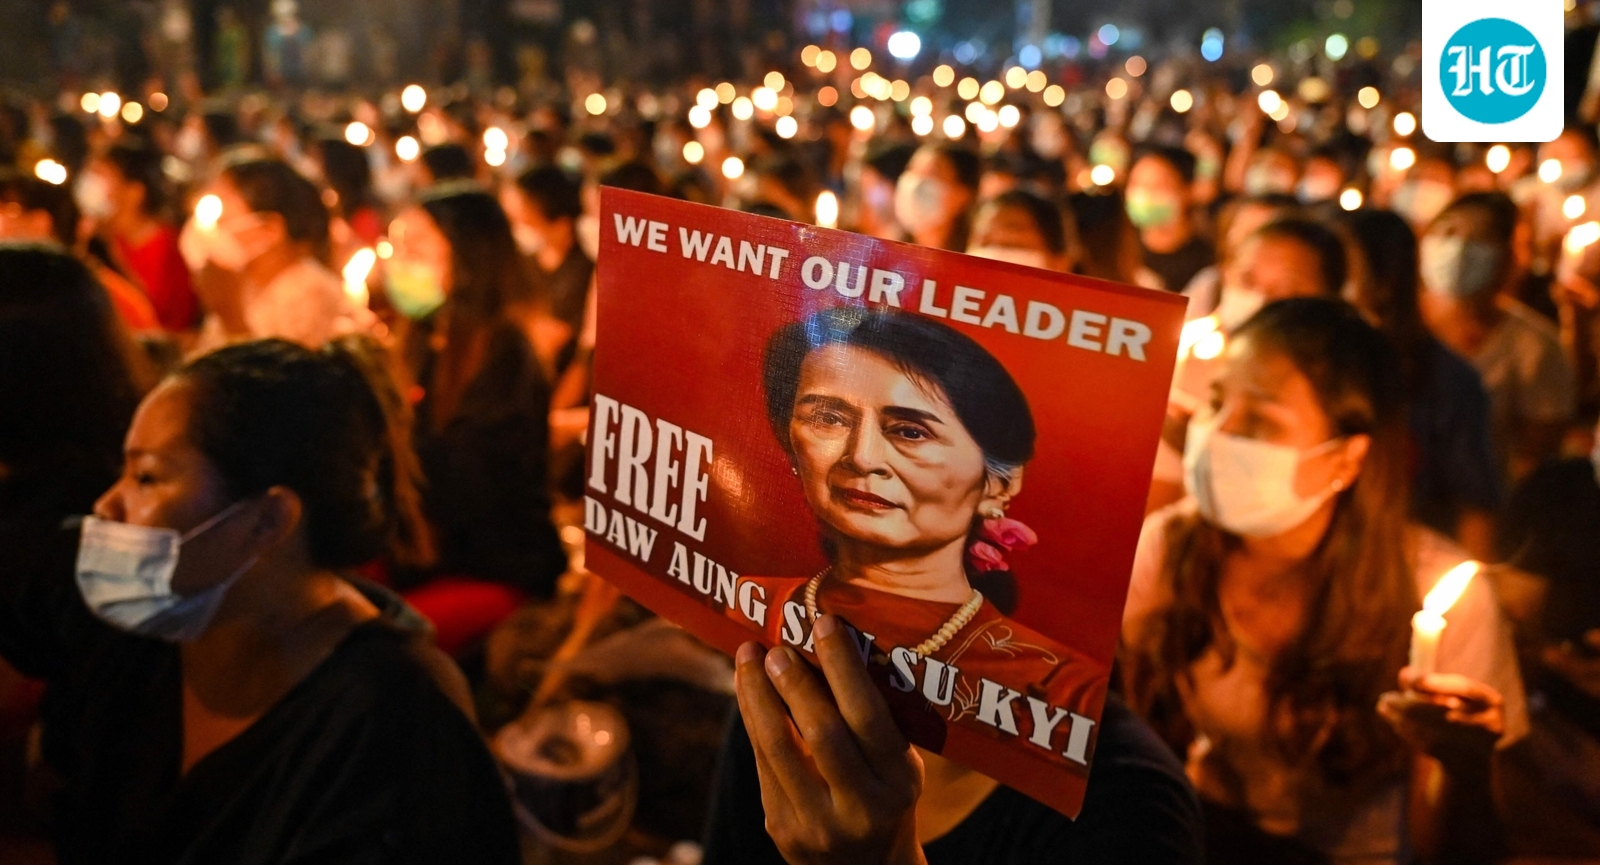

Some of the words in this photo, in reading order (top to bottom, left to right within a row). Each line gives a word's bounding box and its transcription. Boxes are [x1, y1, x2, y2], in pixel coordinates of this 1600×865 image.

[613, 213, 668, 253] WE
[679, 227, 789, 280] WANT
[801, 255, 905, 309] OUR
[920, 279, 1153, 362] LEADER
[588, 393, 713, 542] FREE
[584, 495, 658, 563] DAW
[667, 541, 768, 628] AUNG
[890, 646, 959, 706] SU
[976, 677, 1096, 766] KYI
